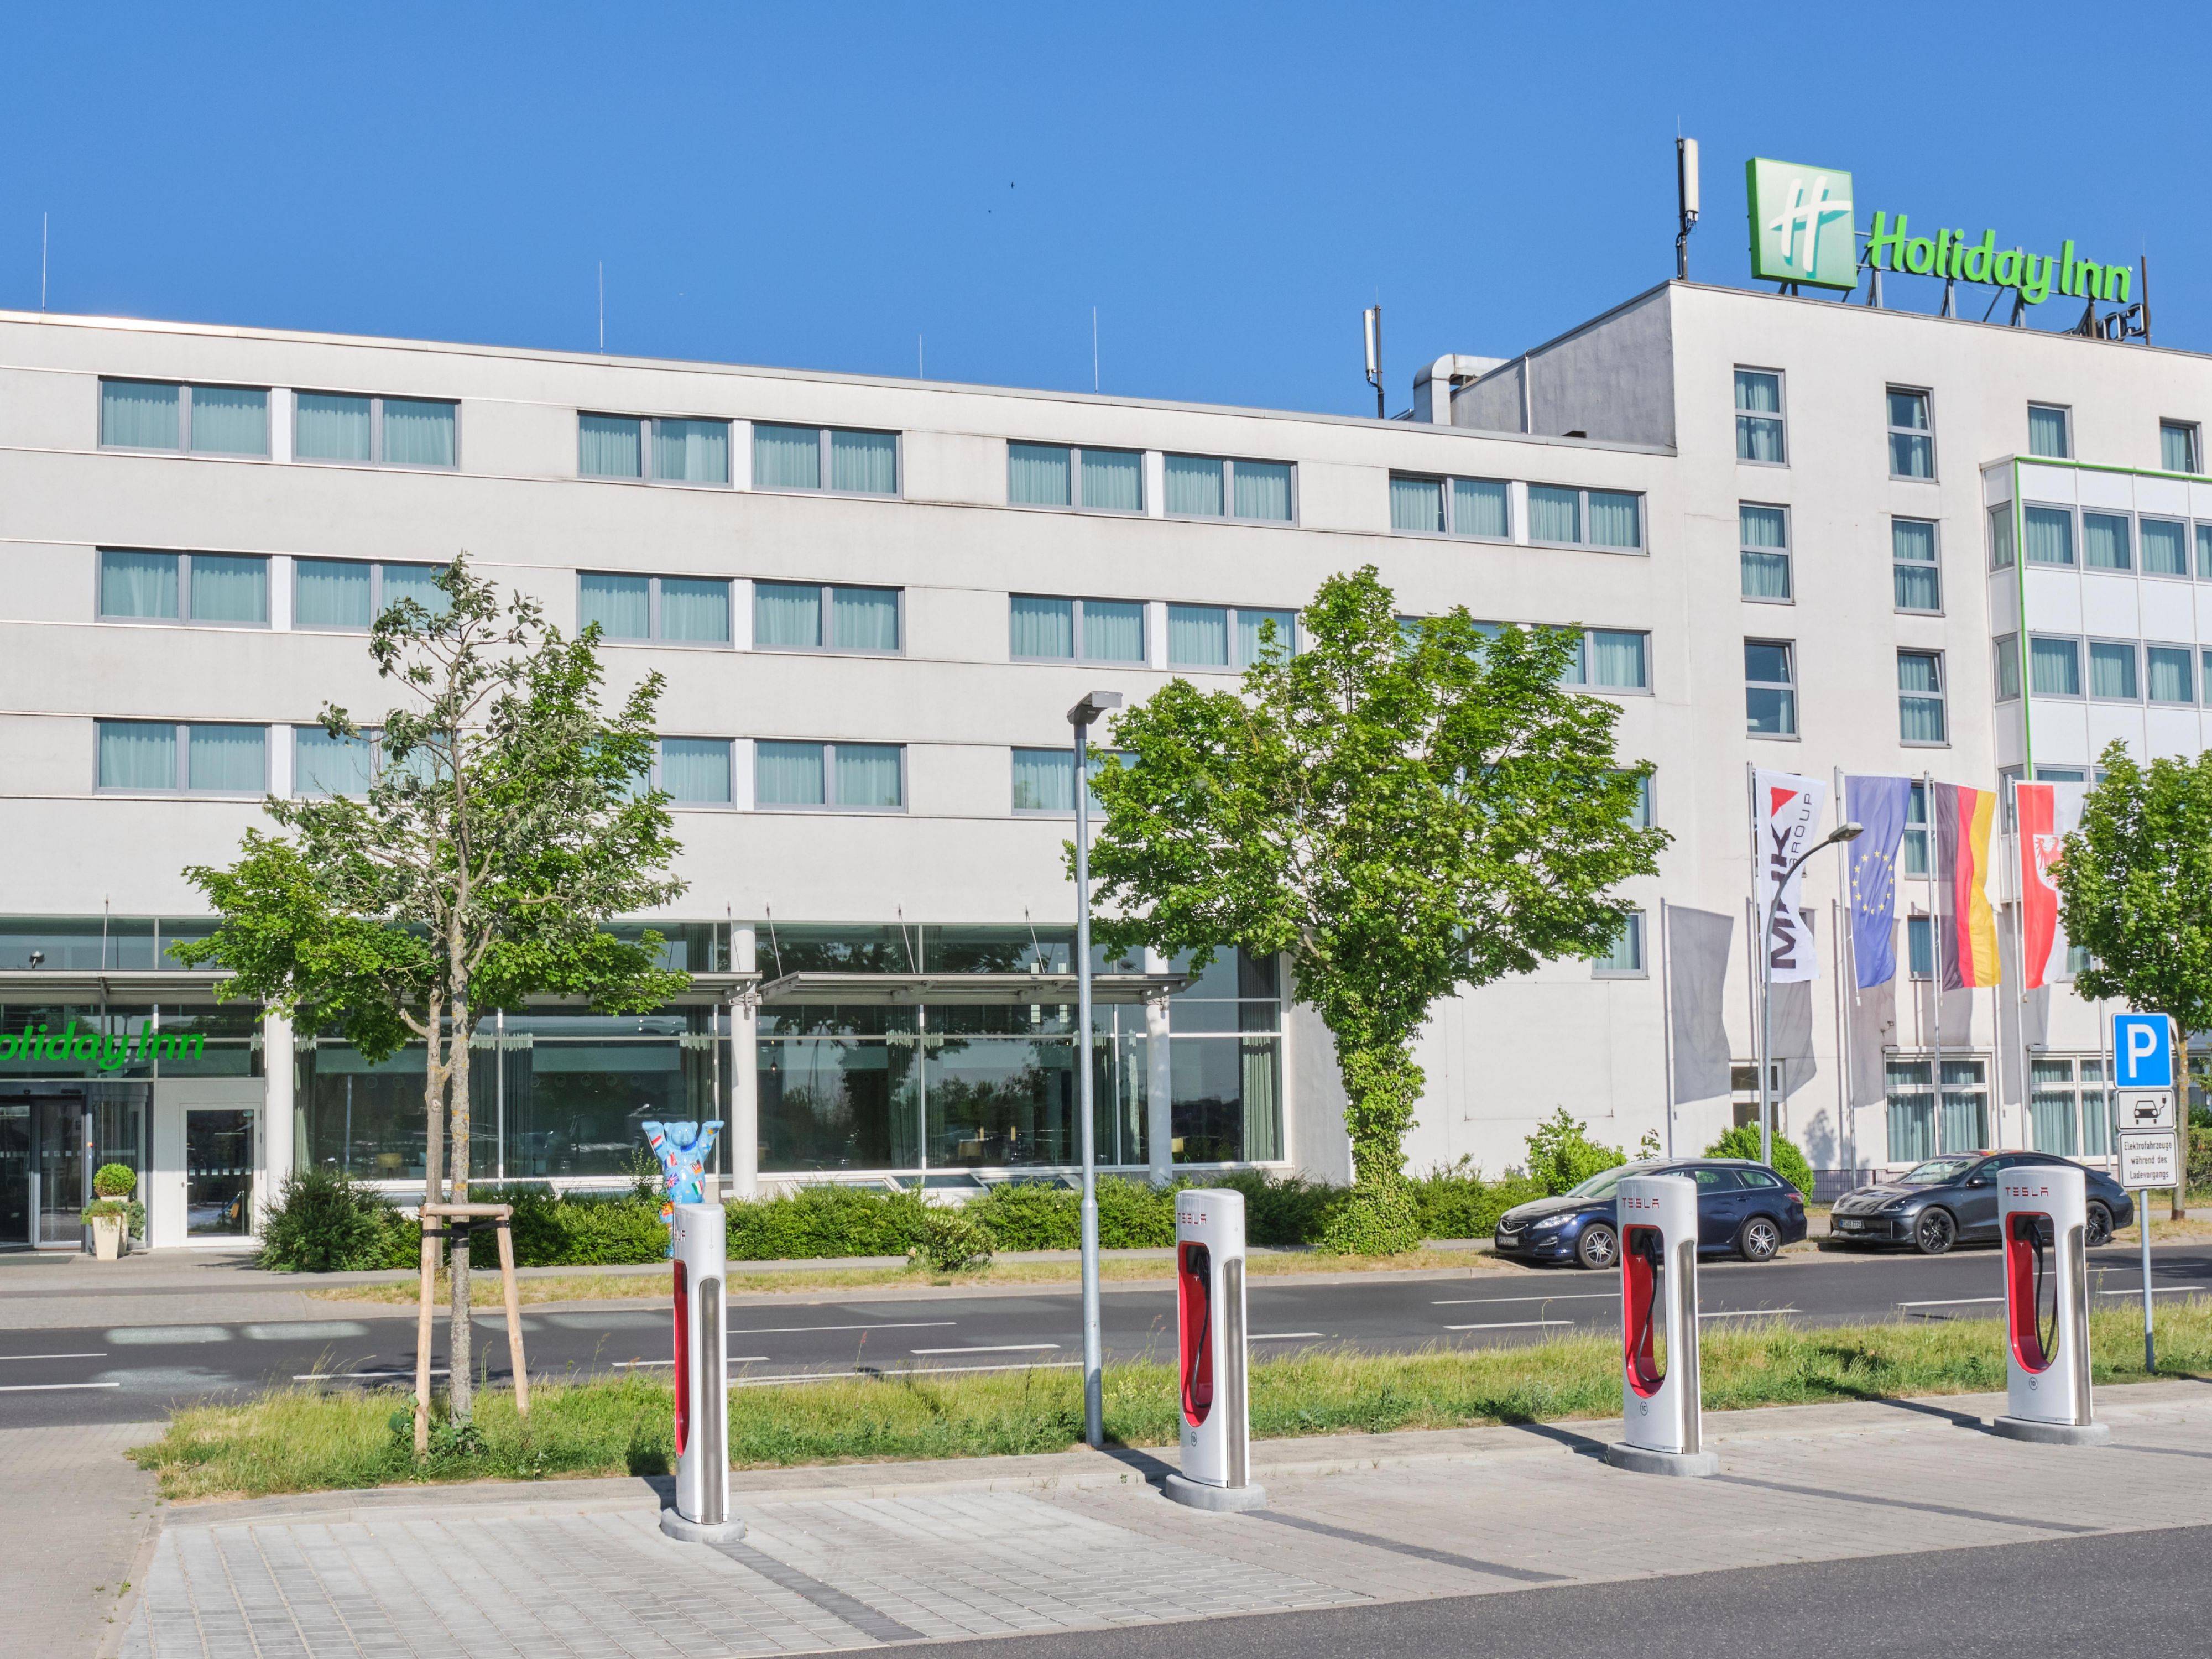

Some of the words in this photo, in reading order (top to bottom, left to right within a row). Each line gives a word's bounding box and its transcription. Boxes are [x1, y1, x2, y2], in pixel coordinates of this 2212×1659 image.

[1866, 211, 2052, 305] Holiday
[2058, 239, 2132, 304] Inn
[137, 1020, 205, 1060] Inn
[2127, 1024, 2157, 1078] P
[2124, 1141, 2172, 1151] Elektrofahrzeuge
[2131, 1155, 2155, 1165] während
[2157, 1155, 2167, 1164] des
[2130, 1170, 2169, 1181] Ladevorgangs
[2005, 1187, 2048, 1197] TESLA
[1621, 1197, 1659, 1209] TESLA
[1177, 1212, 1207, 1225] TESLA
